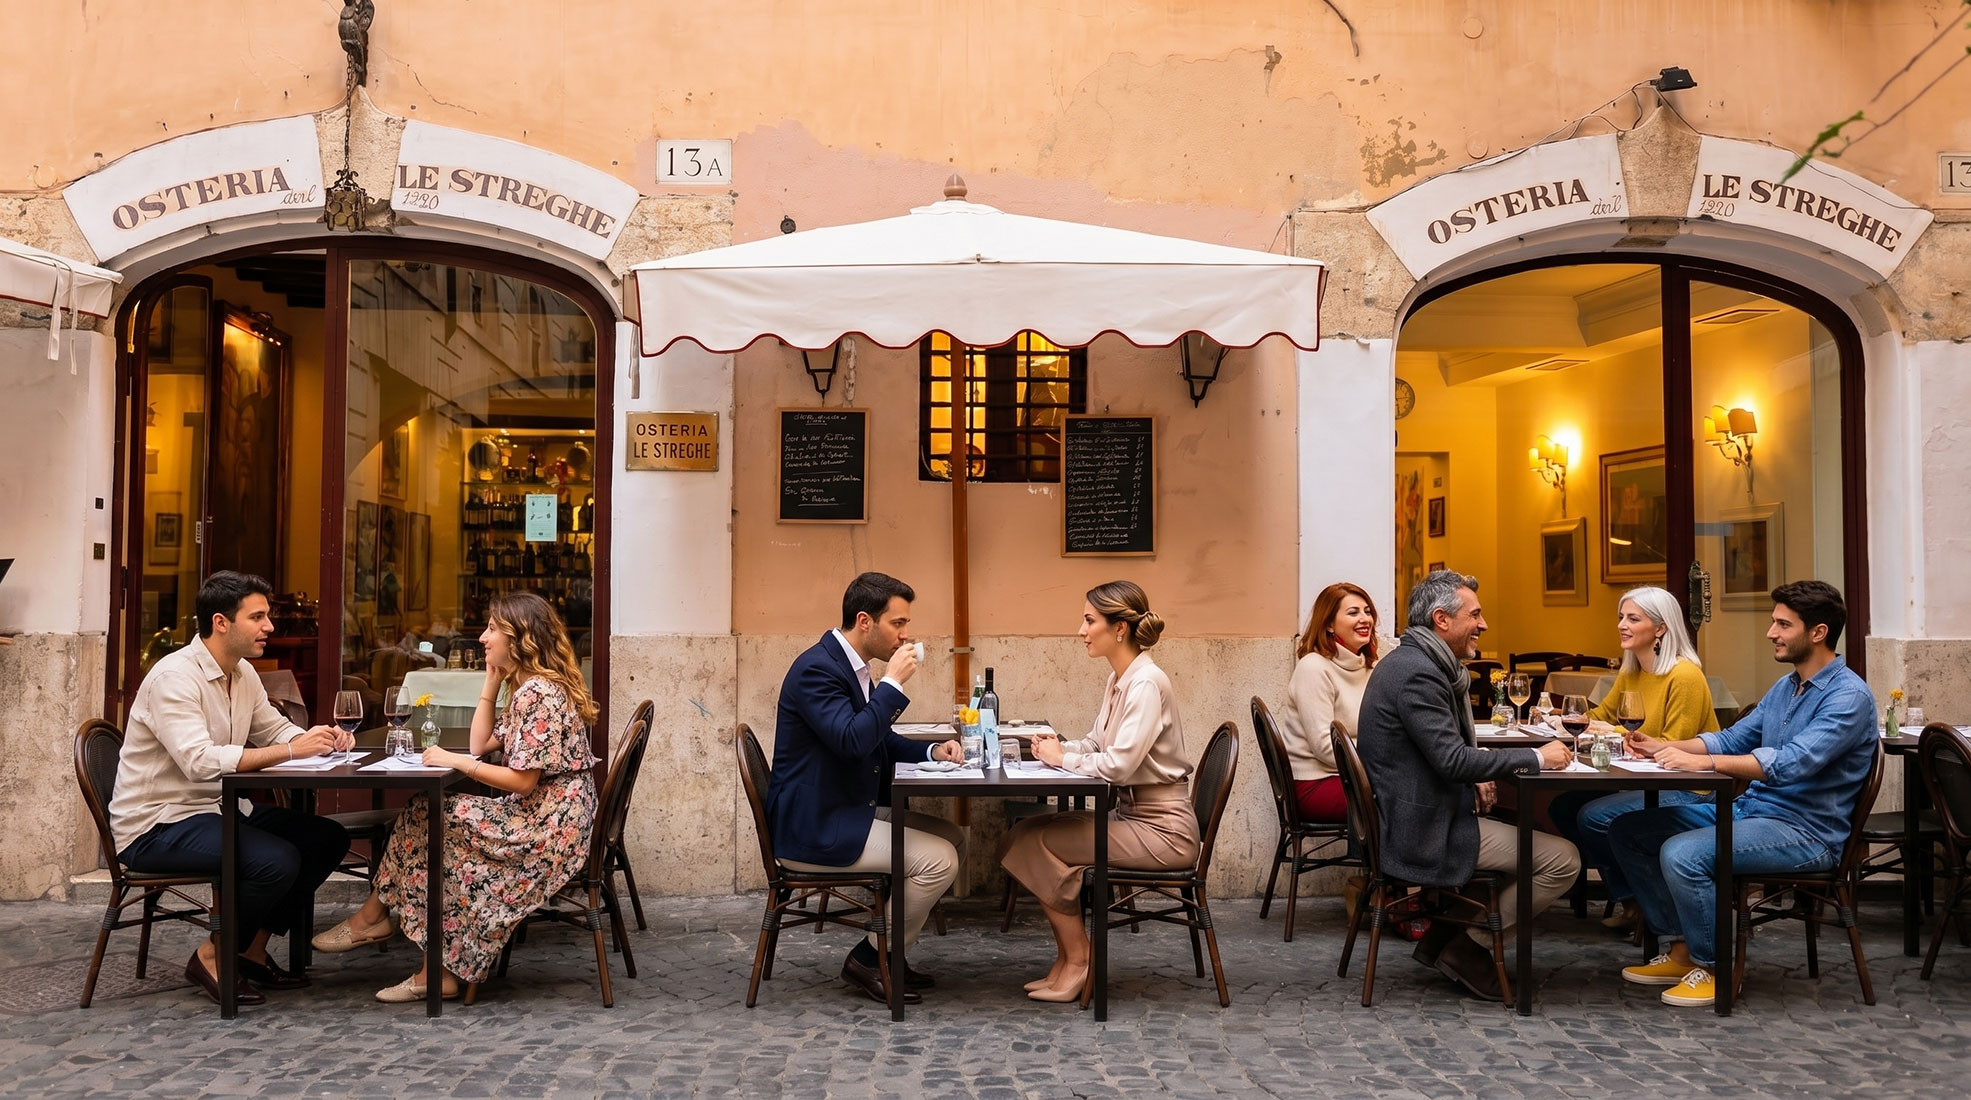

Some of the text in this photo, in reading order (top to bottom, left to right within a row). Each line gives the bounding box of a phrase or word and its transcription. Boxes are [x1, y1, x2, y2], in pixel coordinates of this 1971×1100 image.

[112, 165, 617, 239] OSTERIA LE STREGHE
[1427, 174, 1902, 253] OSTERIA LE STREGHE
[633, 441, 711, 459] LE STREGHE
[636, 423, 708, 437] OSTERIA
